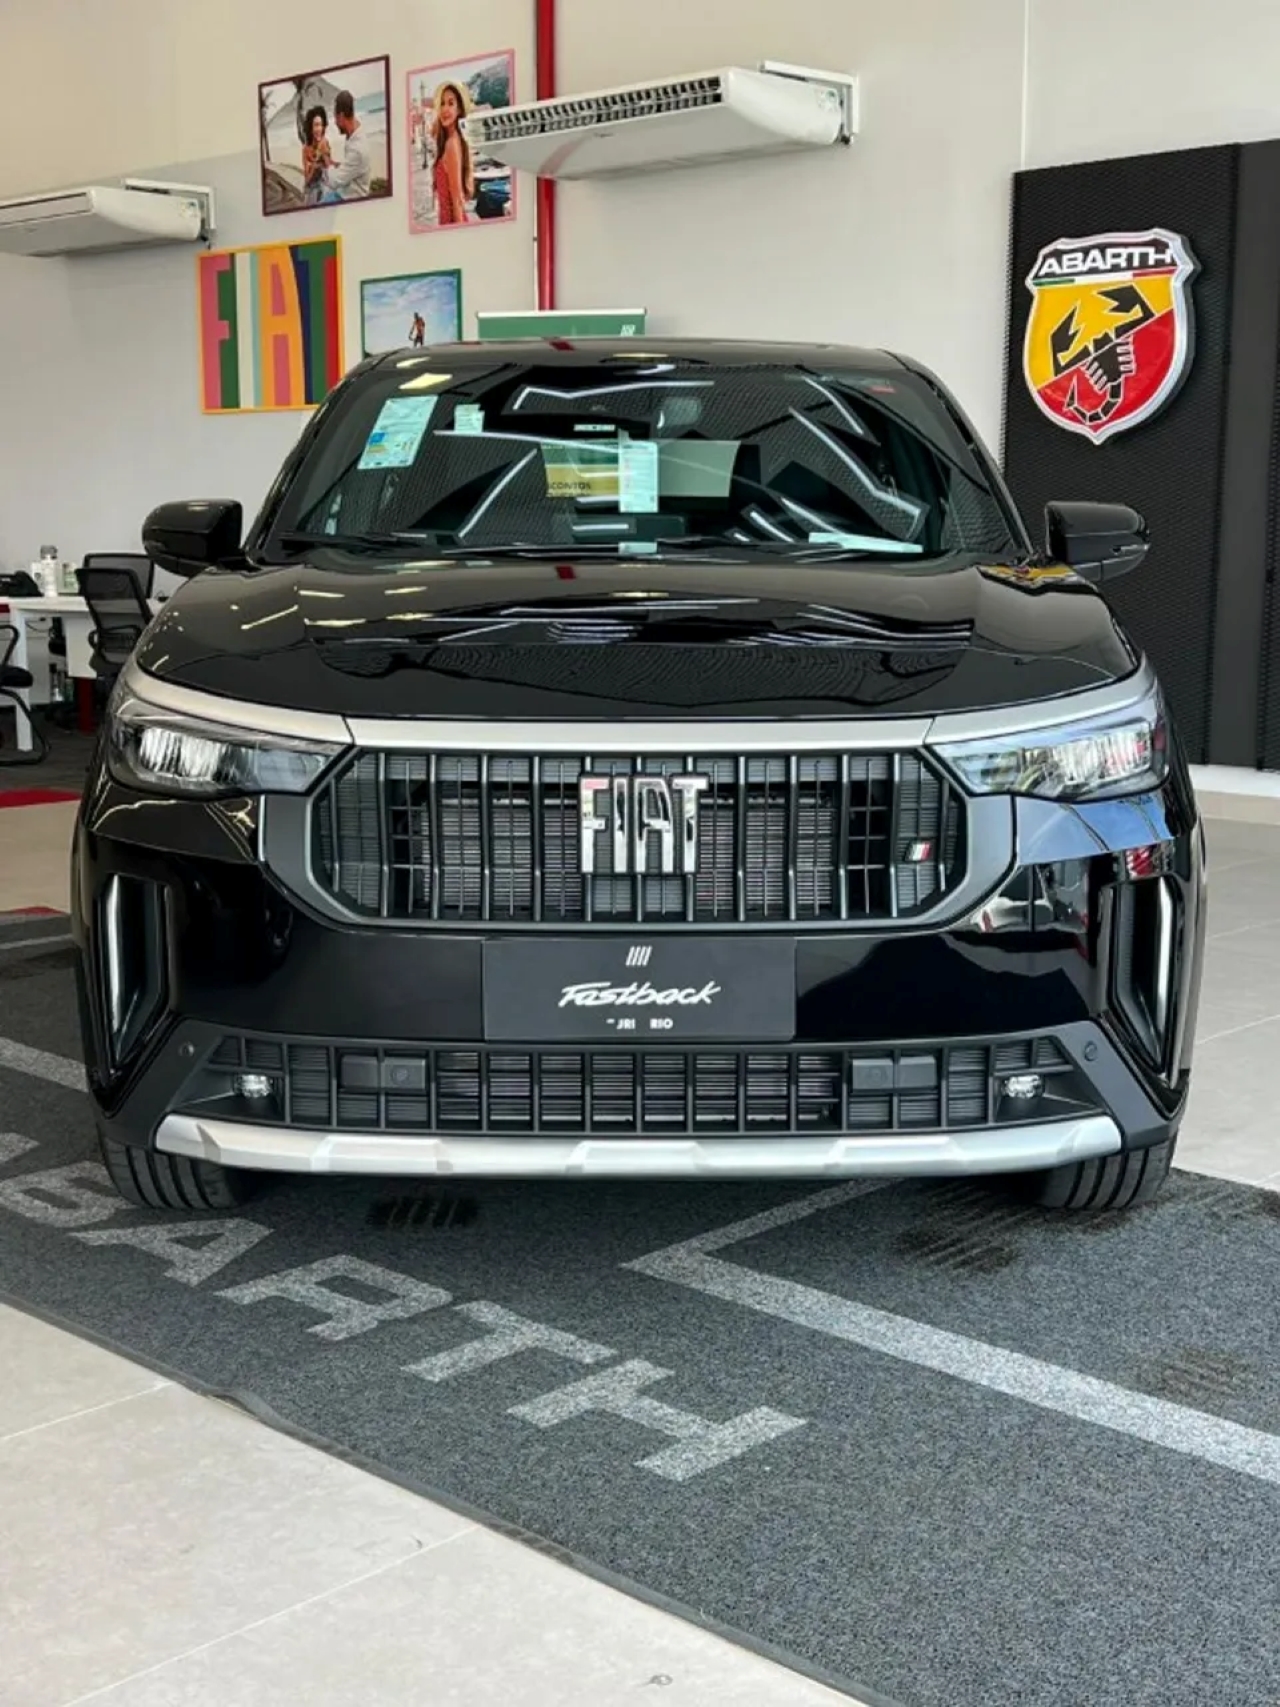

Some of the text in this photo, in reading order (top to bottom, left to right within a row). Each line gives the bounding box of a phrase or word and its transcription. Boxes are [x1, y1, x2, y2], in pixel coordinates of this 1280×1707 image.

[1038, 246, 1172, 277] ABARTH
[200, 241, 340, 409] FIAT
[580, 776, 709, 874] FIAT
[558, 980, 722, 1008] Fastback
[0, 1132, 808, 1482] BARTH
